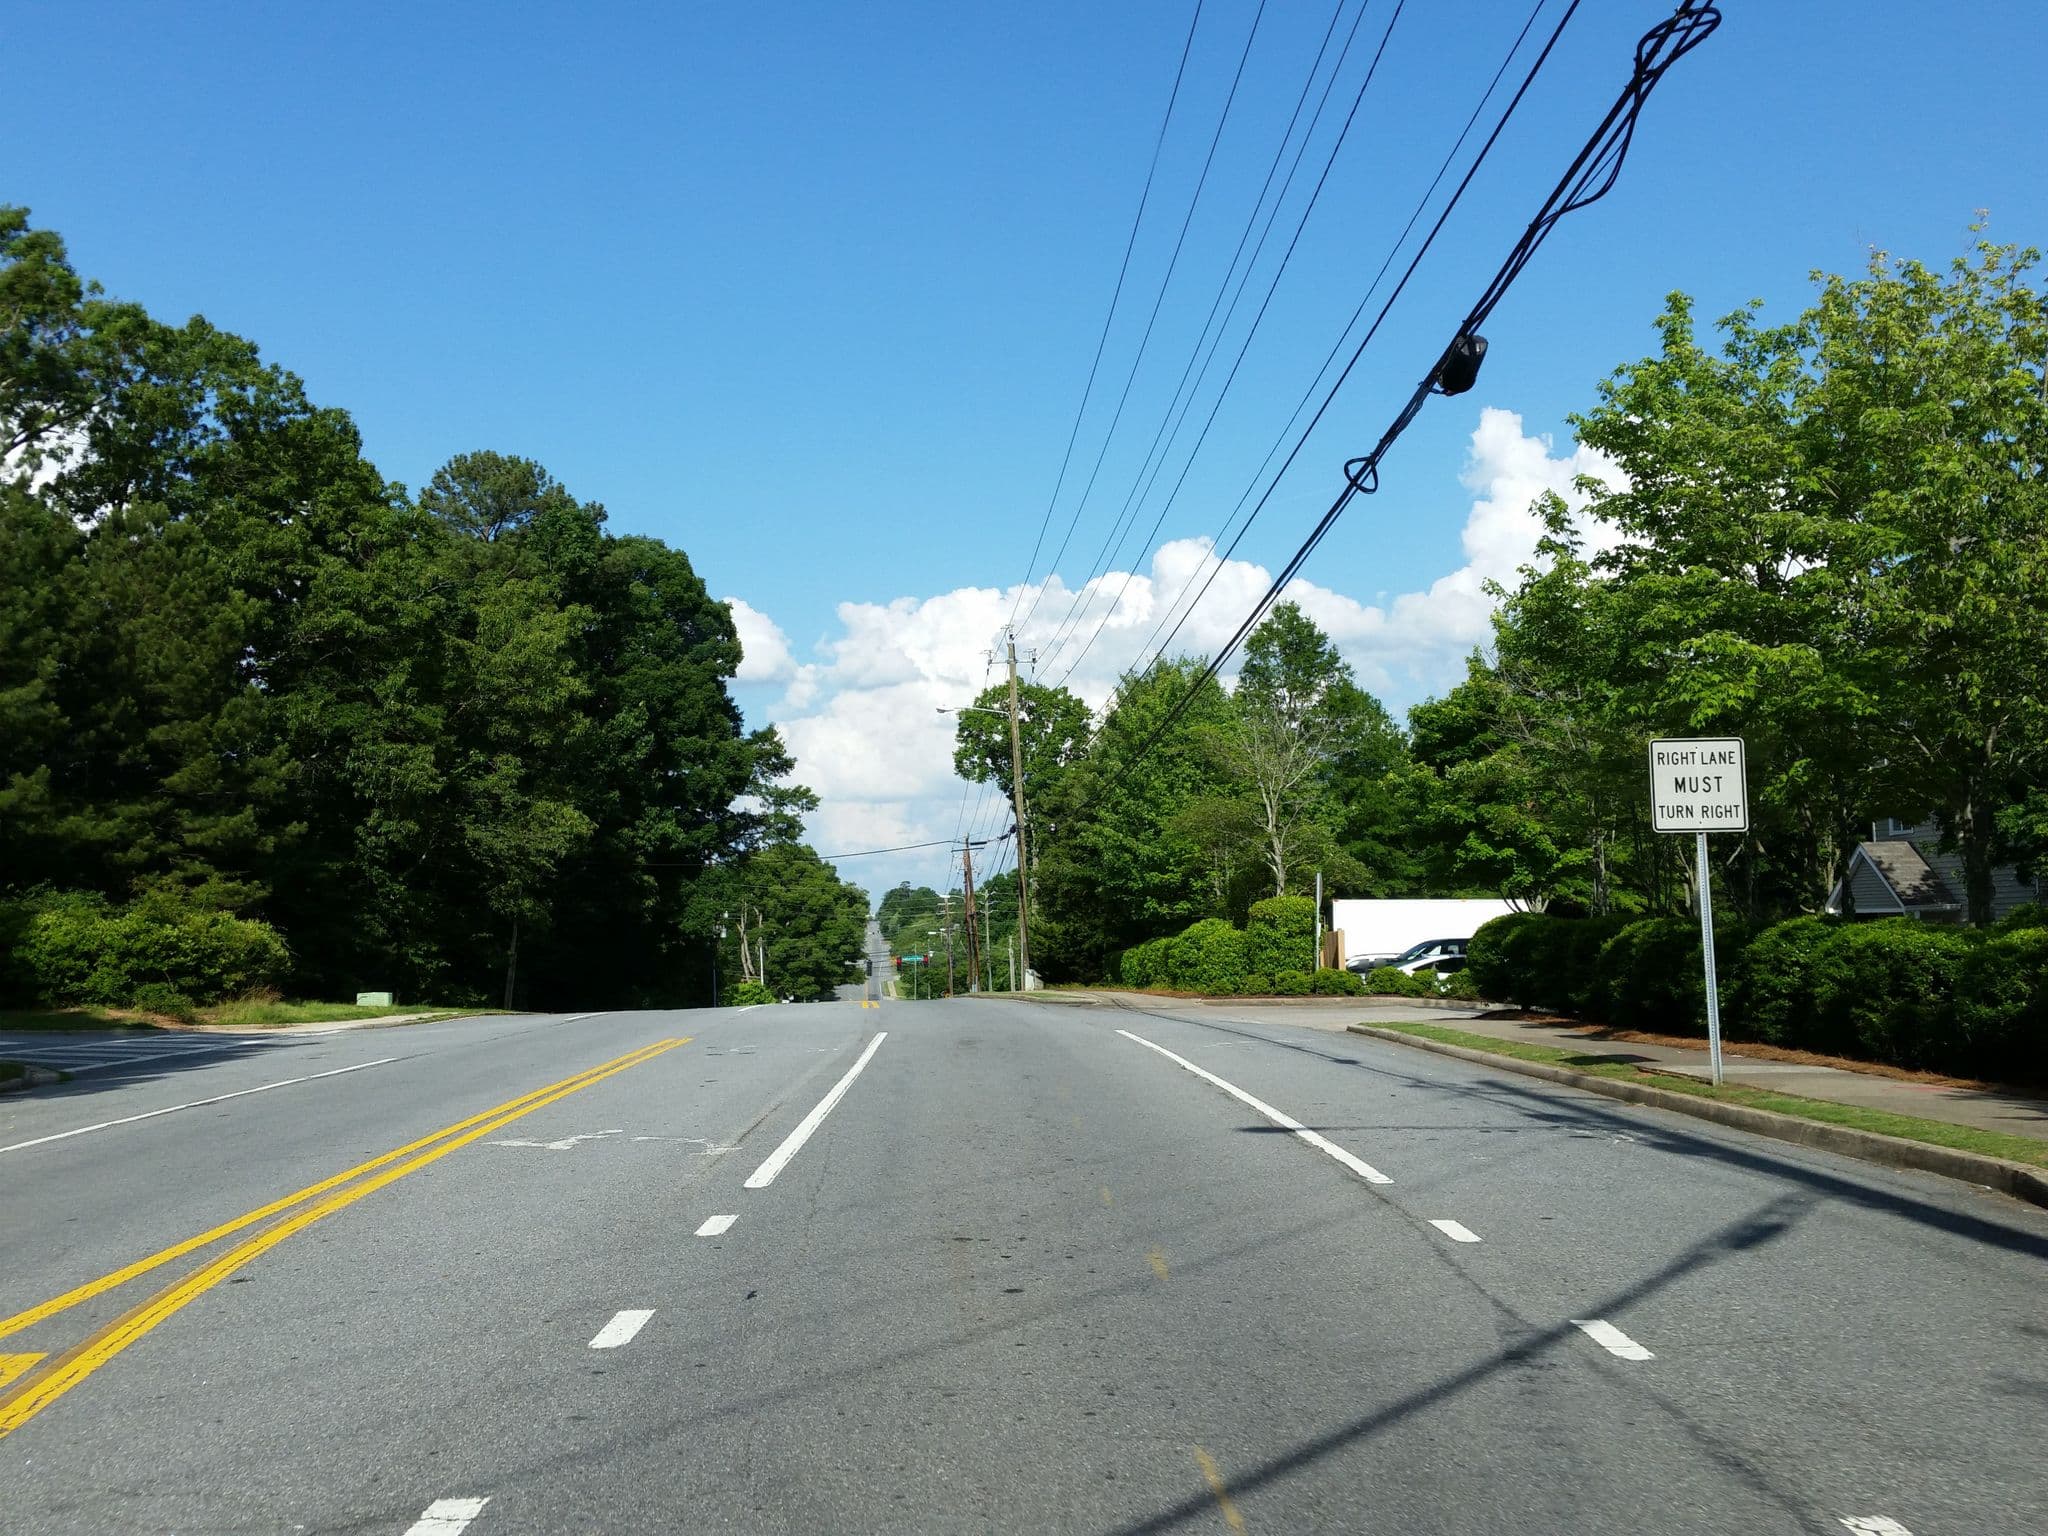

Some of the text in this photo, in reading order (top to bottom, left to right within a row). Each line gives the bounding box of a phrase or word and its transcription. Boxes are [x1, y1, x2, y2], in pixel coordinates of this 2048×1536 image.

[1657, 751, 1736, 765] RIGHT LANE
[1674, 776, 1723, 793] MUST
[1658, 804, 1740, 819] TURN RIGHT
